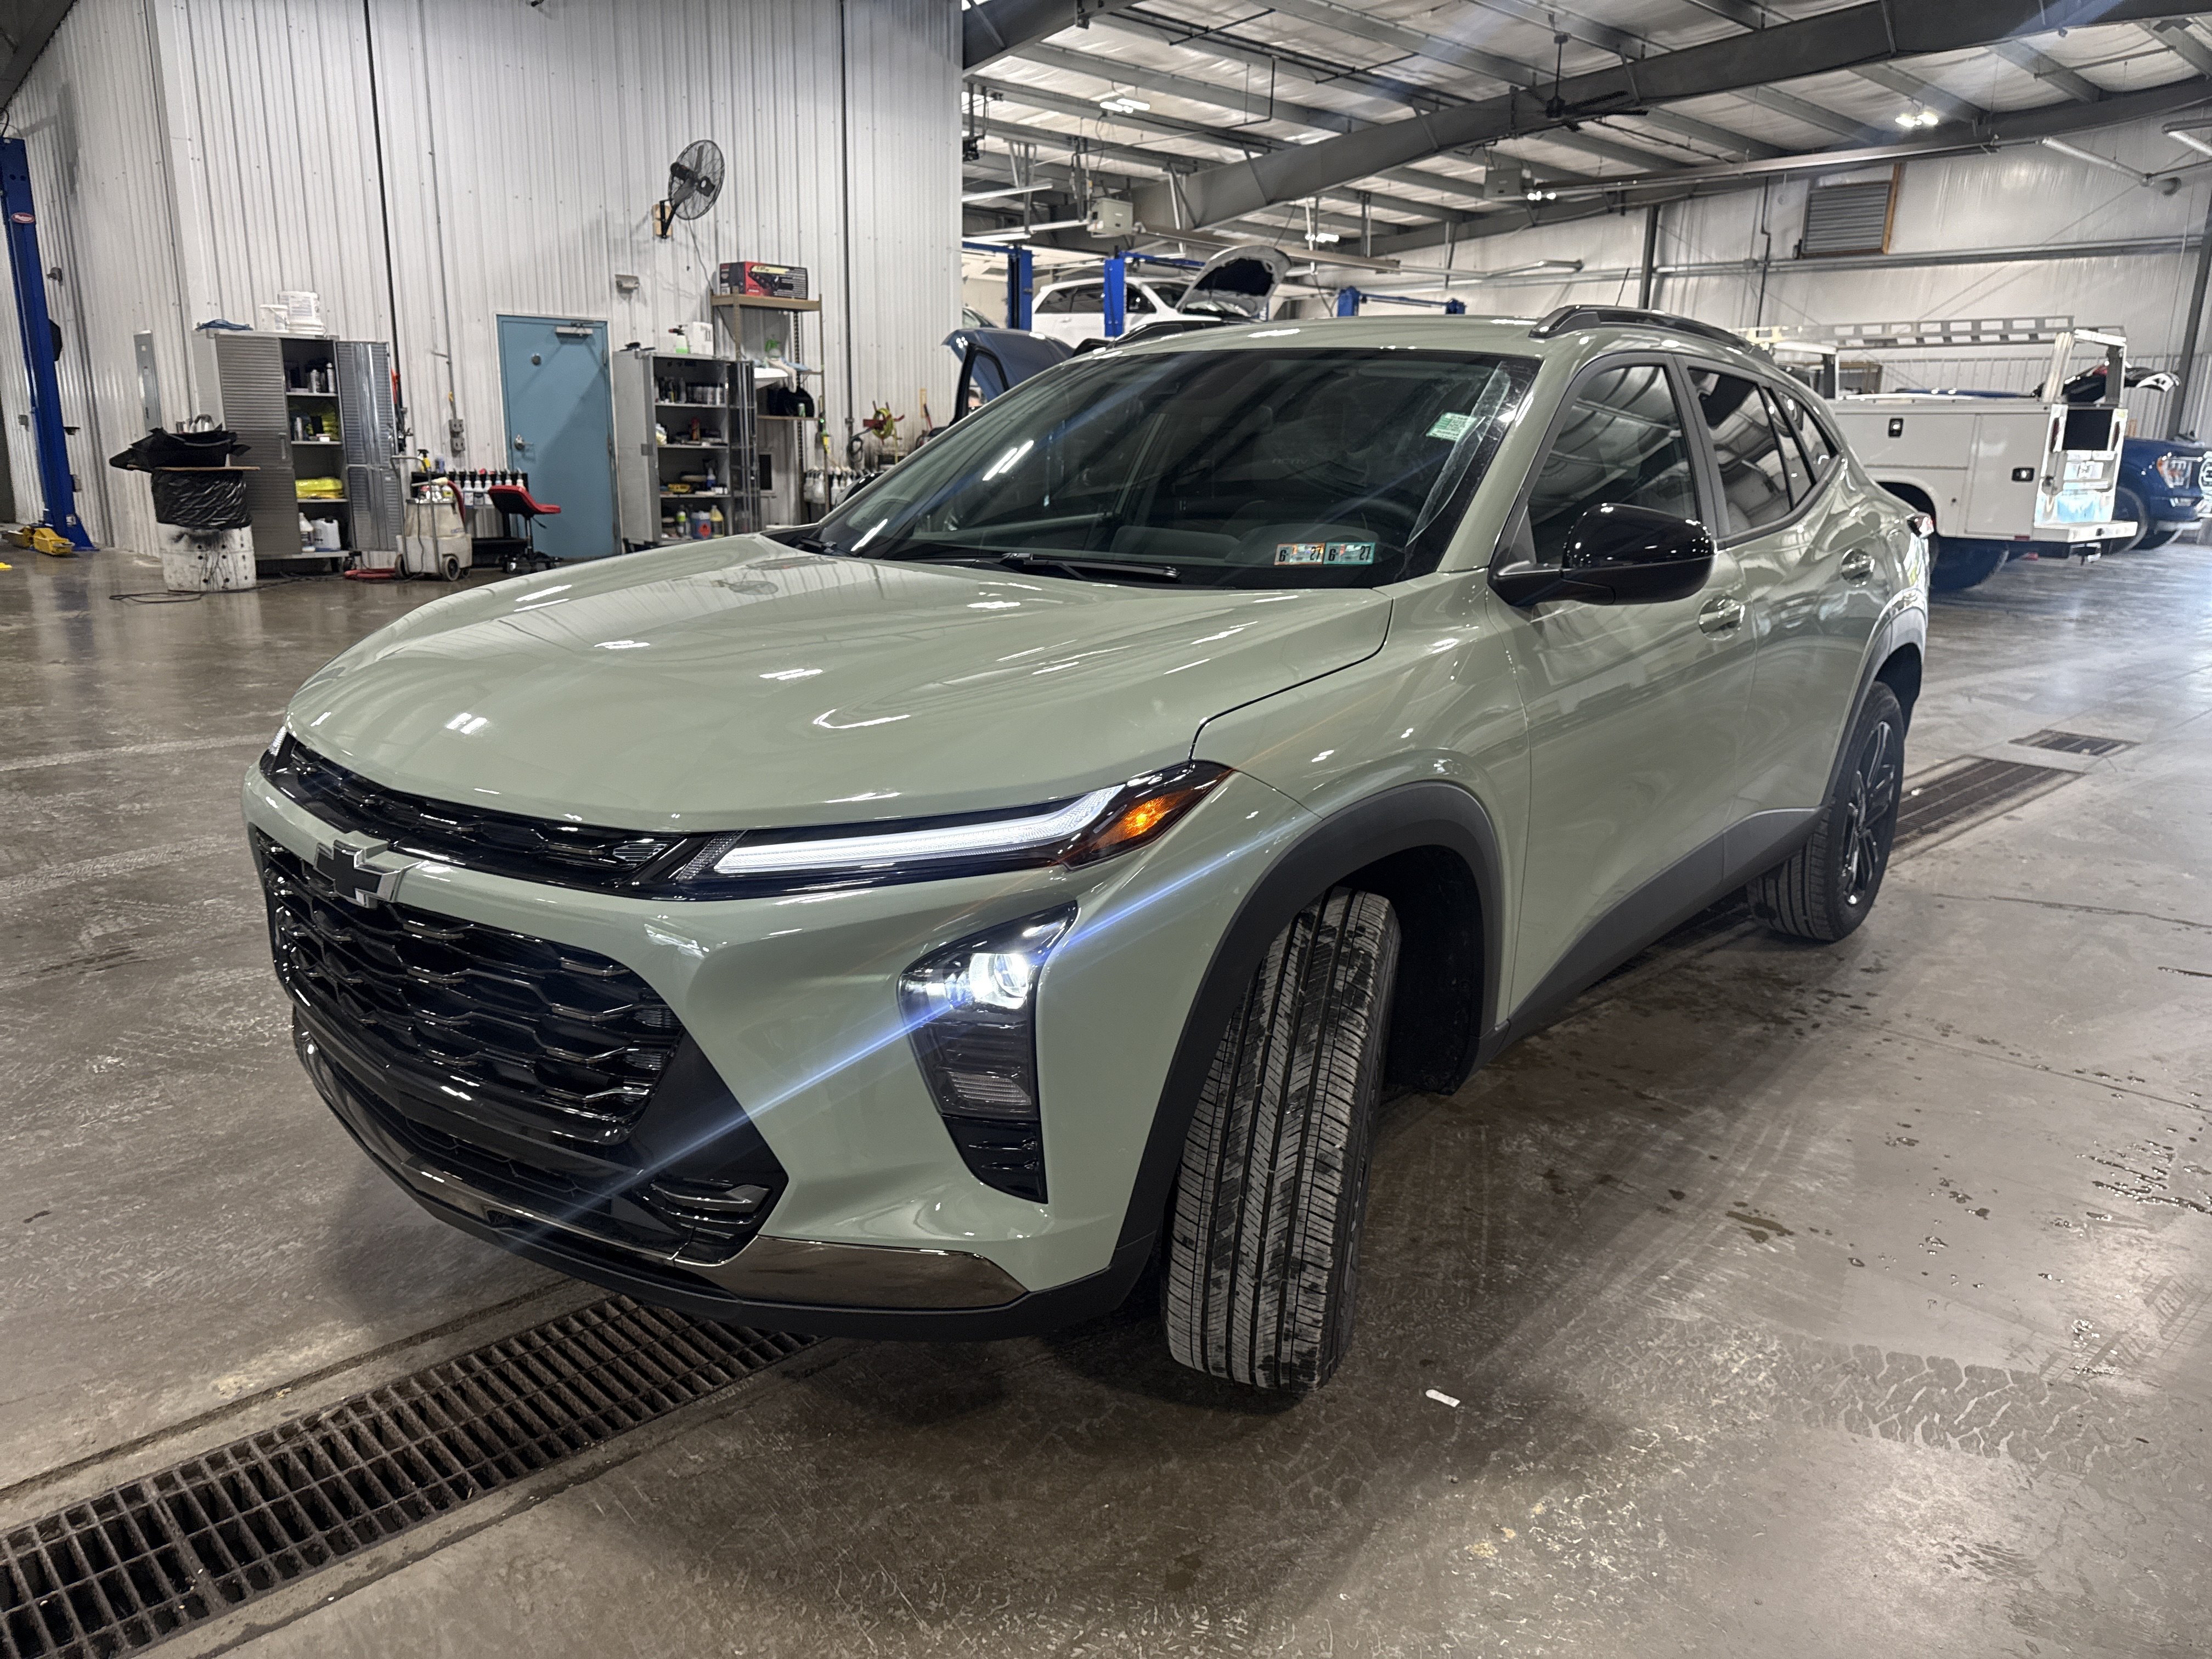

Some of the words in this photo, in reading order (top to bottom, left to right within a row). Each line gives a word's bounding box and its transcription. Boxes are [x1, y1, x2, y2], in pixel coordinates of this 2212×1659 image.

[1279, 549, 1287, 562] 6
[1310, 546, 1322, 561] 27
[1328, 548, 1336, 561] 6
[1359, 545, 1372, 560] 27
